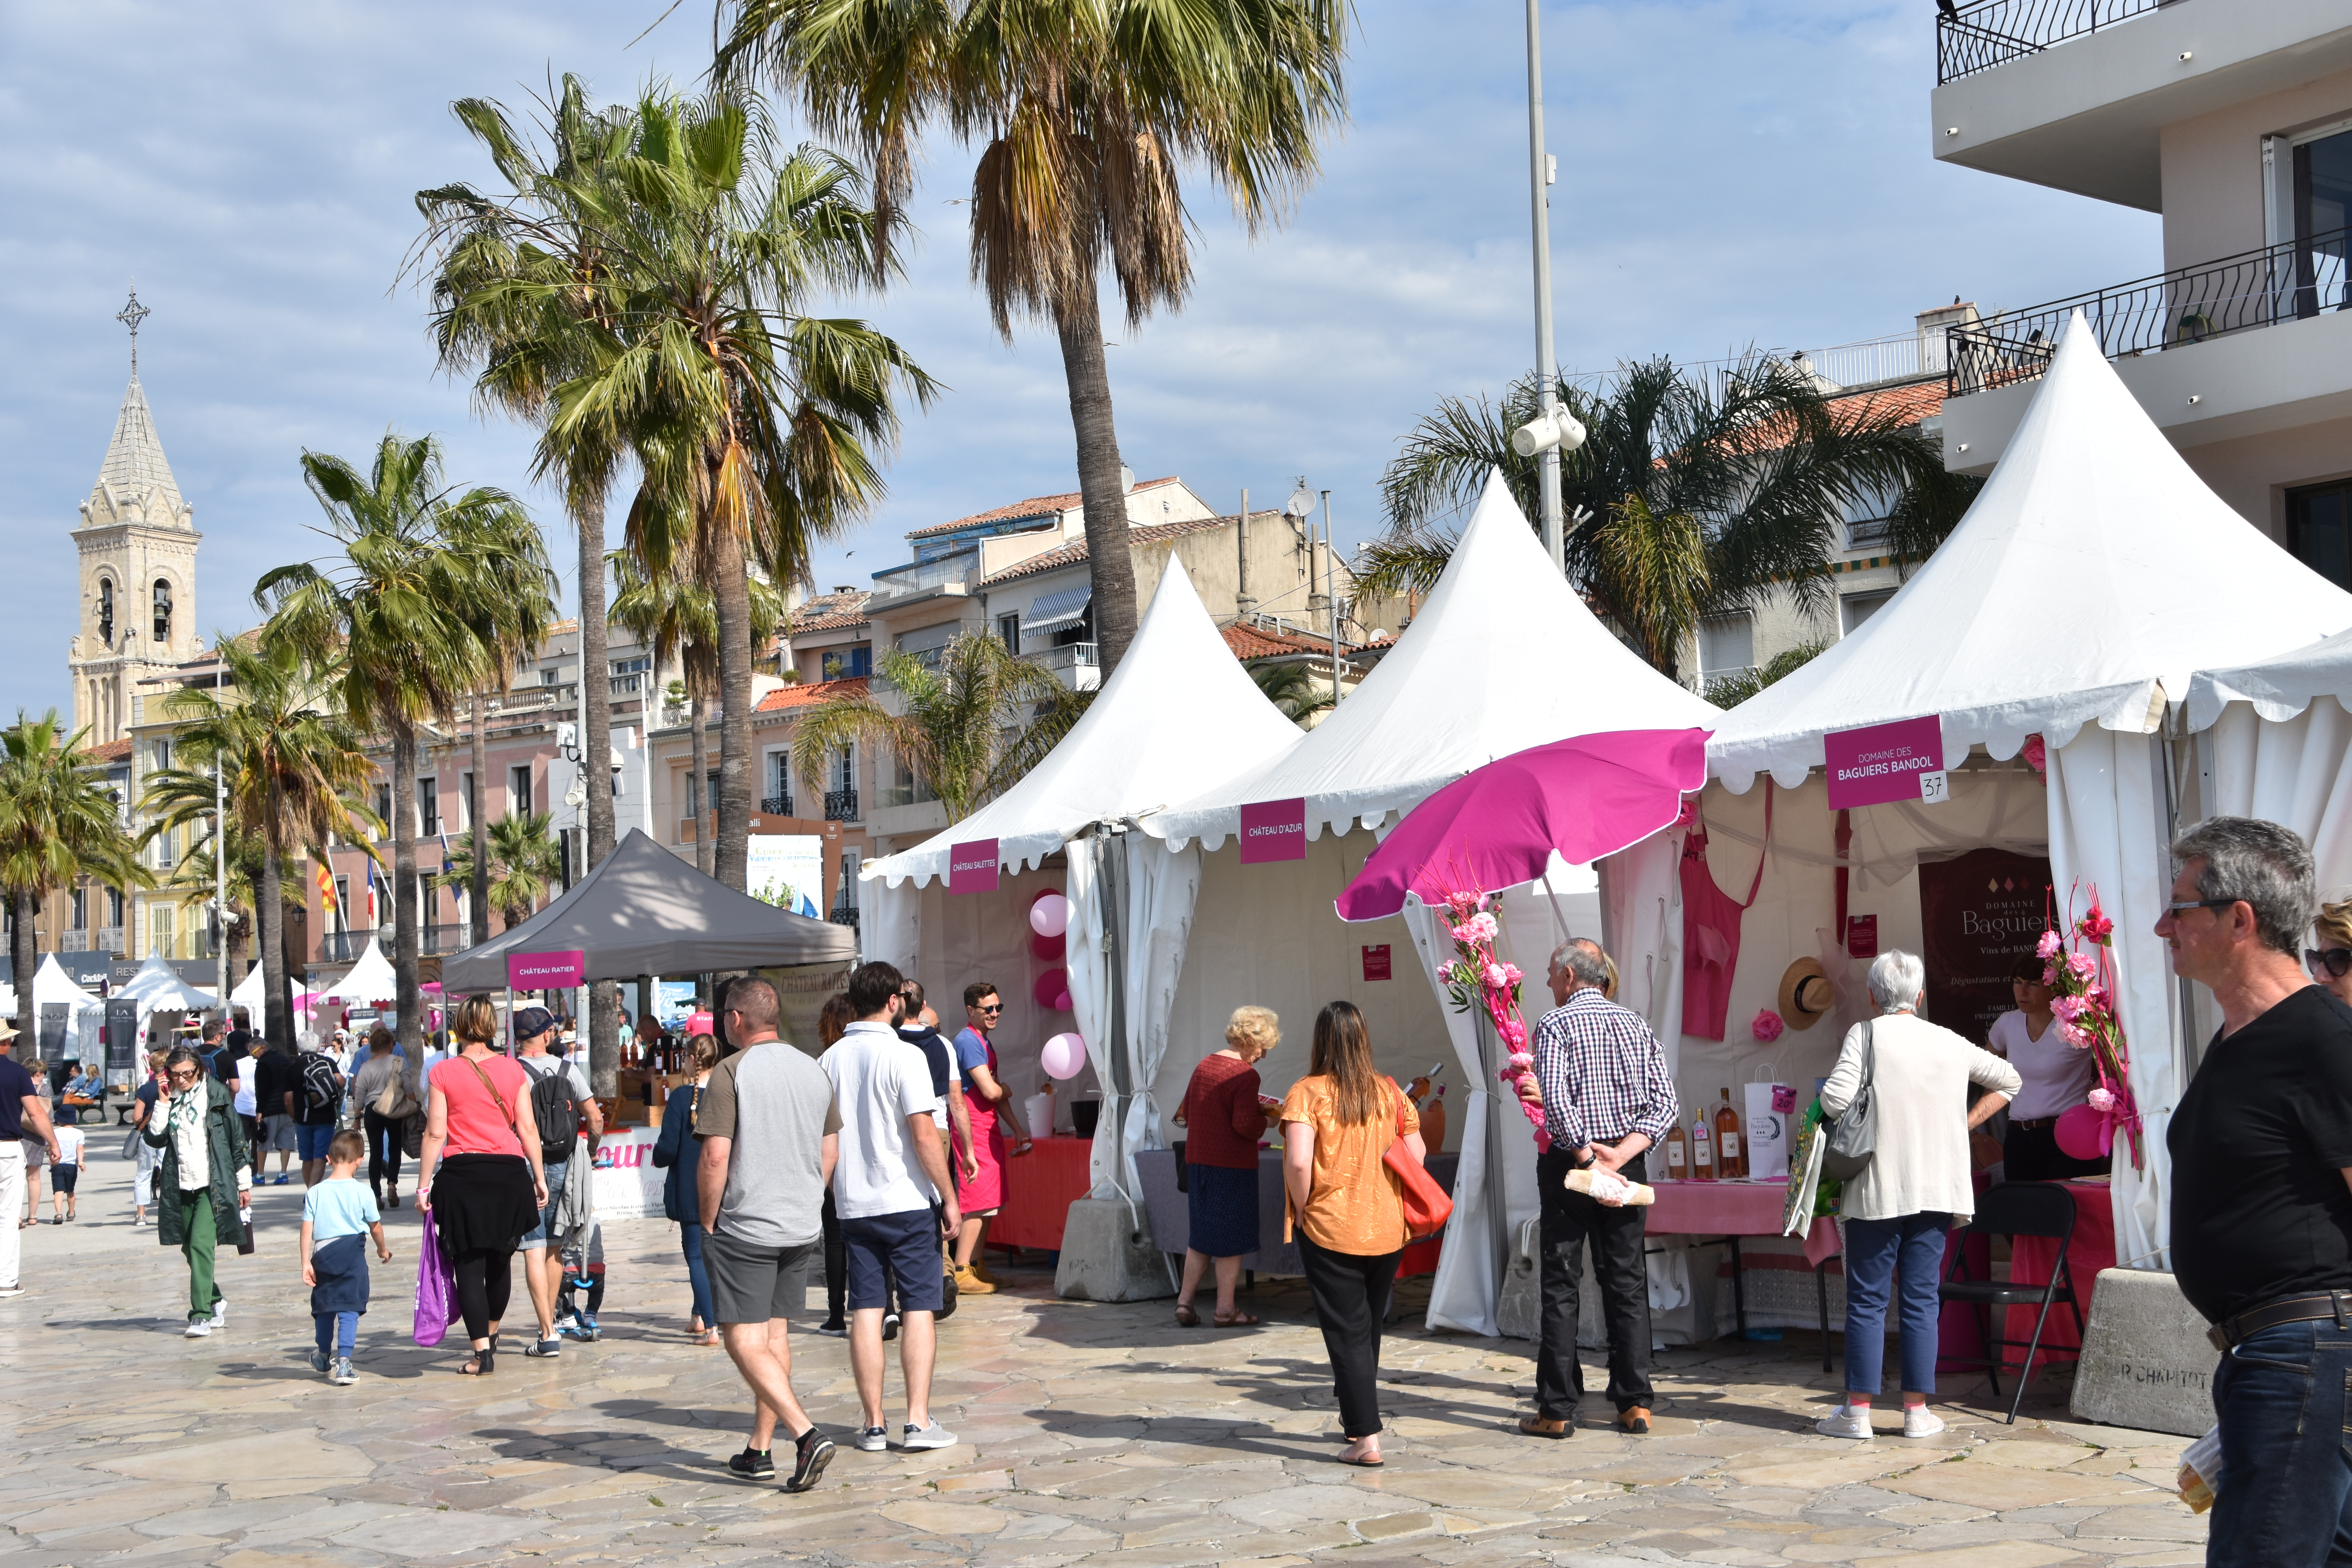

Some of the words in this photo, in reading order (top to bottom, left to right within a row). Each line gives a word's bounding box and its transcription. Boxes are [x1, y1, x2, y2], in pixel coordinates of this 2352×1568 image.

[1858, 749, 1895, 763] DOMAINE
[1896, 746, 1911, 756] DES
[1838, 762, 1888, 780] BAGUIERS
[1892, 756, 1933, 772] BANDOL
[1923, 777, 1942, 796] 37
[1249, 825, 1278, 837] CHÂTEAU
[1279, 823, 1302, 834] D'AZUR
[953, 862, 973, 871] CHÂTEAU
[974, 859, 995, 869] SALETTES
[1986, 900, 2036, 909] DOMAINE
[1962, 911, 2060, 941] Baguiers
[1951, 976, 2000, 986] Dégustation
